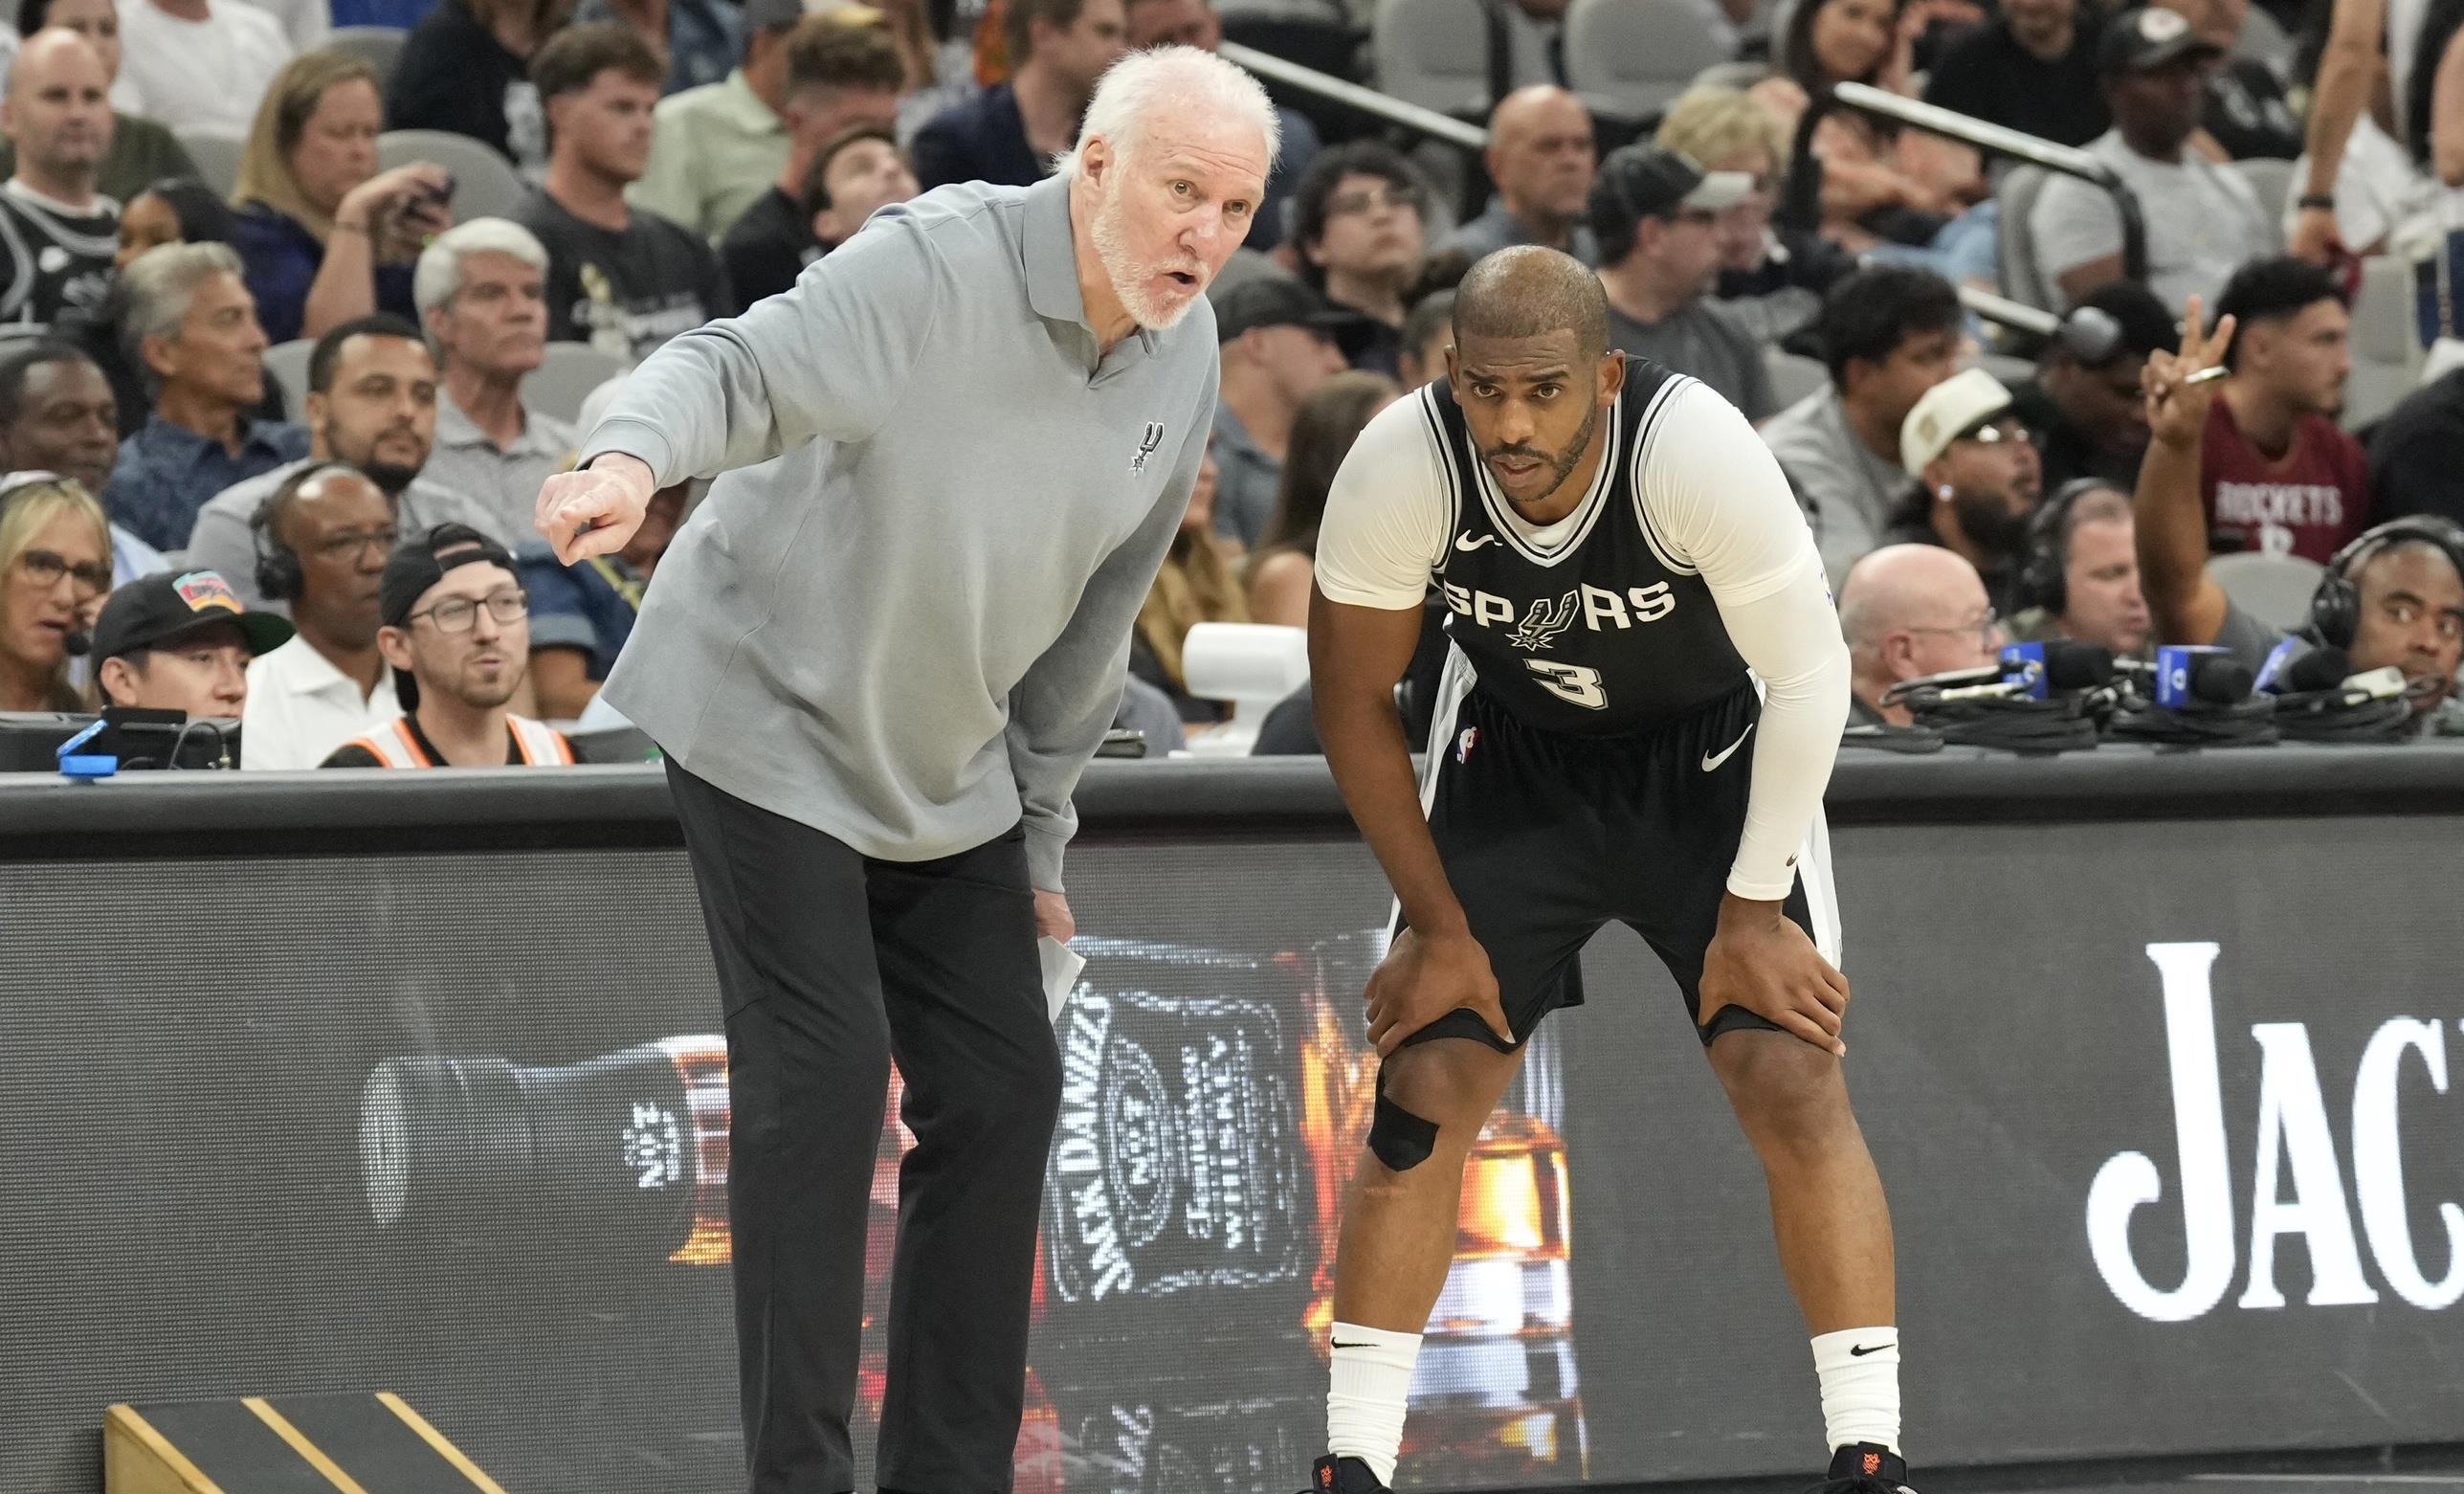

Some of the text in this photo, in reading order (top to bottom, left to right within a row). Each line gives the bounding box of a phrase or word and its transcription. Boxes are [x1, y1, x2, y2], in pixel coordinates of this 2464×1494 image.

[2215, 480, 2343, 525] ROCKETS
[1443, 580, 1676, 652] SPURS
[1522, 658, 1609, 711] 3
[2086, 941, 2464, 1322] JAC
[1071, 1176, 1135, 1302] JACK
